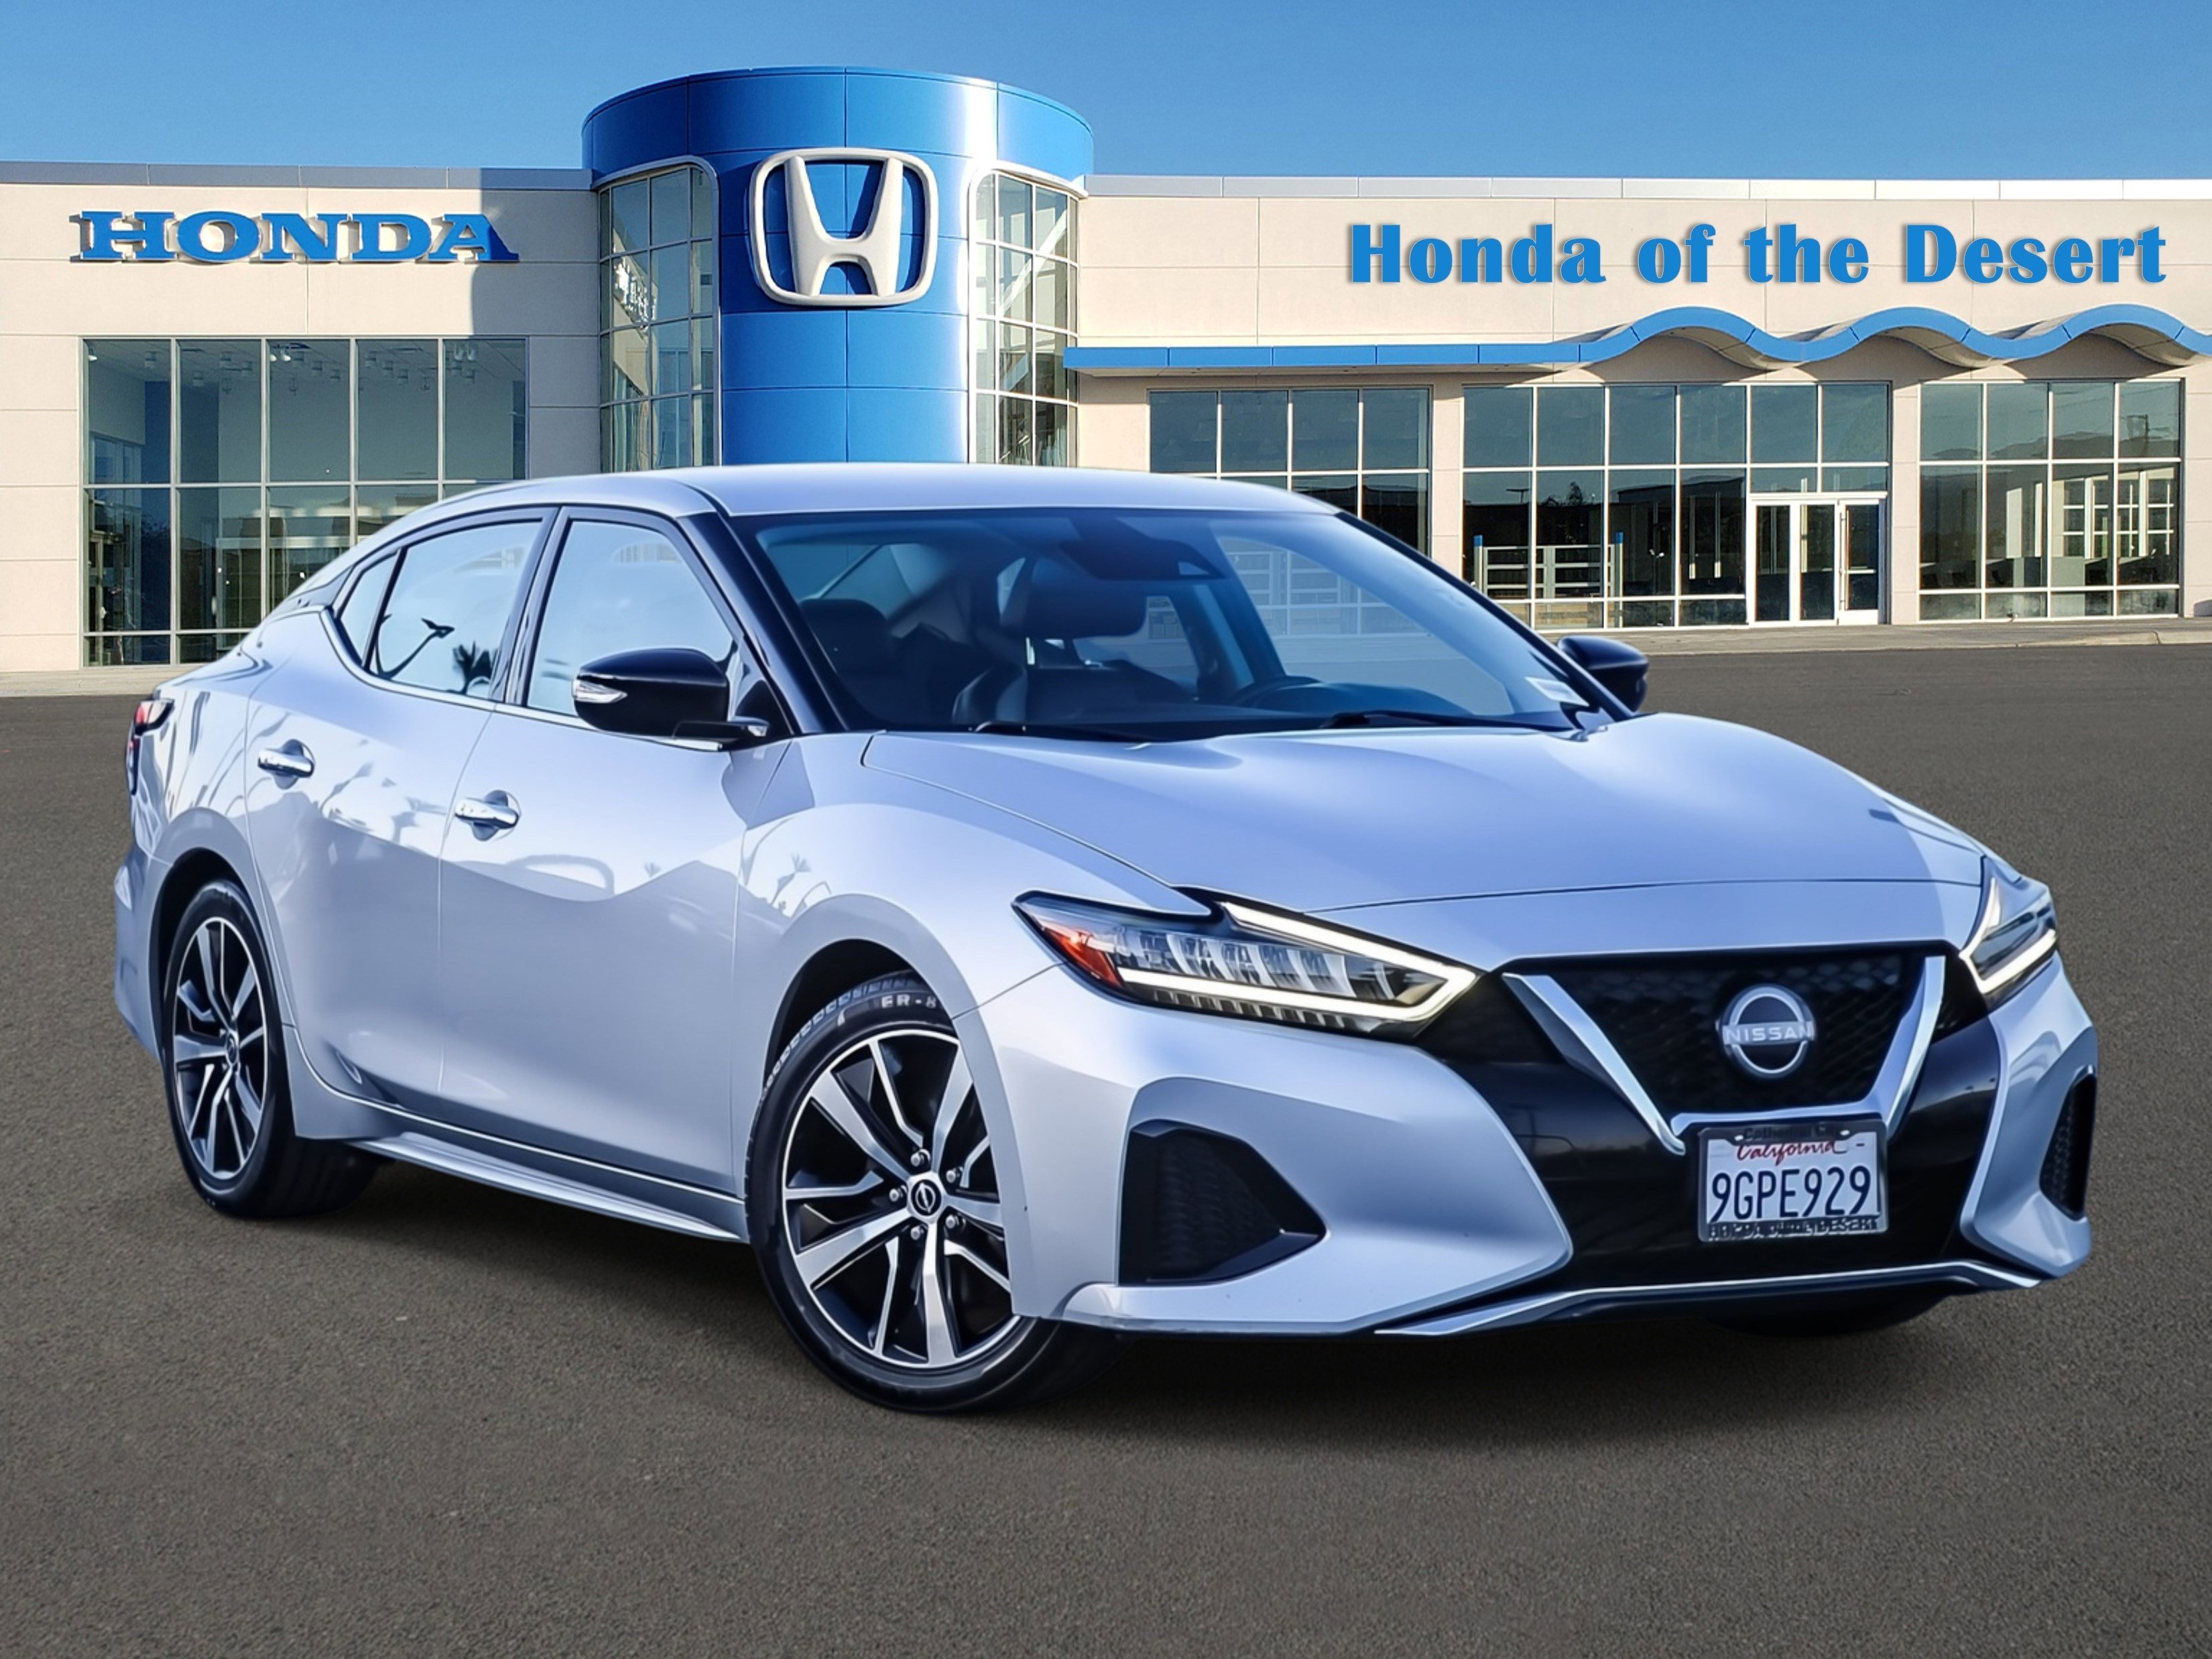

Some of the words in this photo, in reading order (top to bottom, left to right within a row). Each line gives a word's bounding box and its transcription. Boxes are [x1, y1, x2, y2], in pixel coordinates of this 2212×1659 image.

[78, 210, 519, 263] HONDA
[1351, 223, 1606, 284] Honda
[1637, 223, 1716, 284] of
[1743, 224, 1869, 284] the
[1906, 224, 2166, 284] Desert
[1725, 1022, 1814, 1044] NISSAN
[1737, 1139, 1848, 1166] California
[1711, 1165, 1871, 1223] 9GPE929
